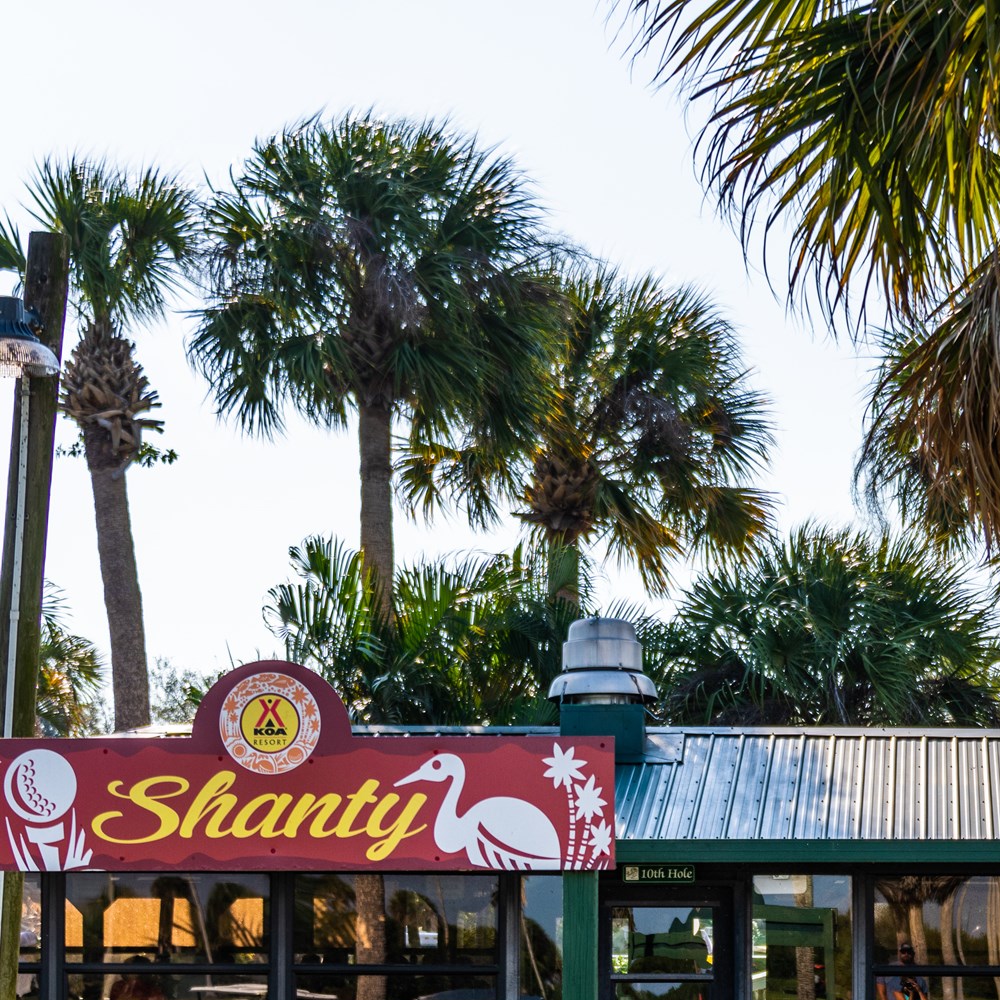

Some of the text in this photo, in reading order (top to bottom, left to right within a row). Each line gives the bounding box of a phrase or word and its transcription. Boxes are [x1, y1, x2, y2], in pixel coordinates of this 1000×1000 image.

[253, 727, 288, 736] KOA
[91, 770, 428, 861] Shanty
[641, 867, 693, 879] 10th Hole
